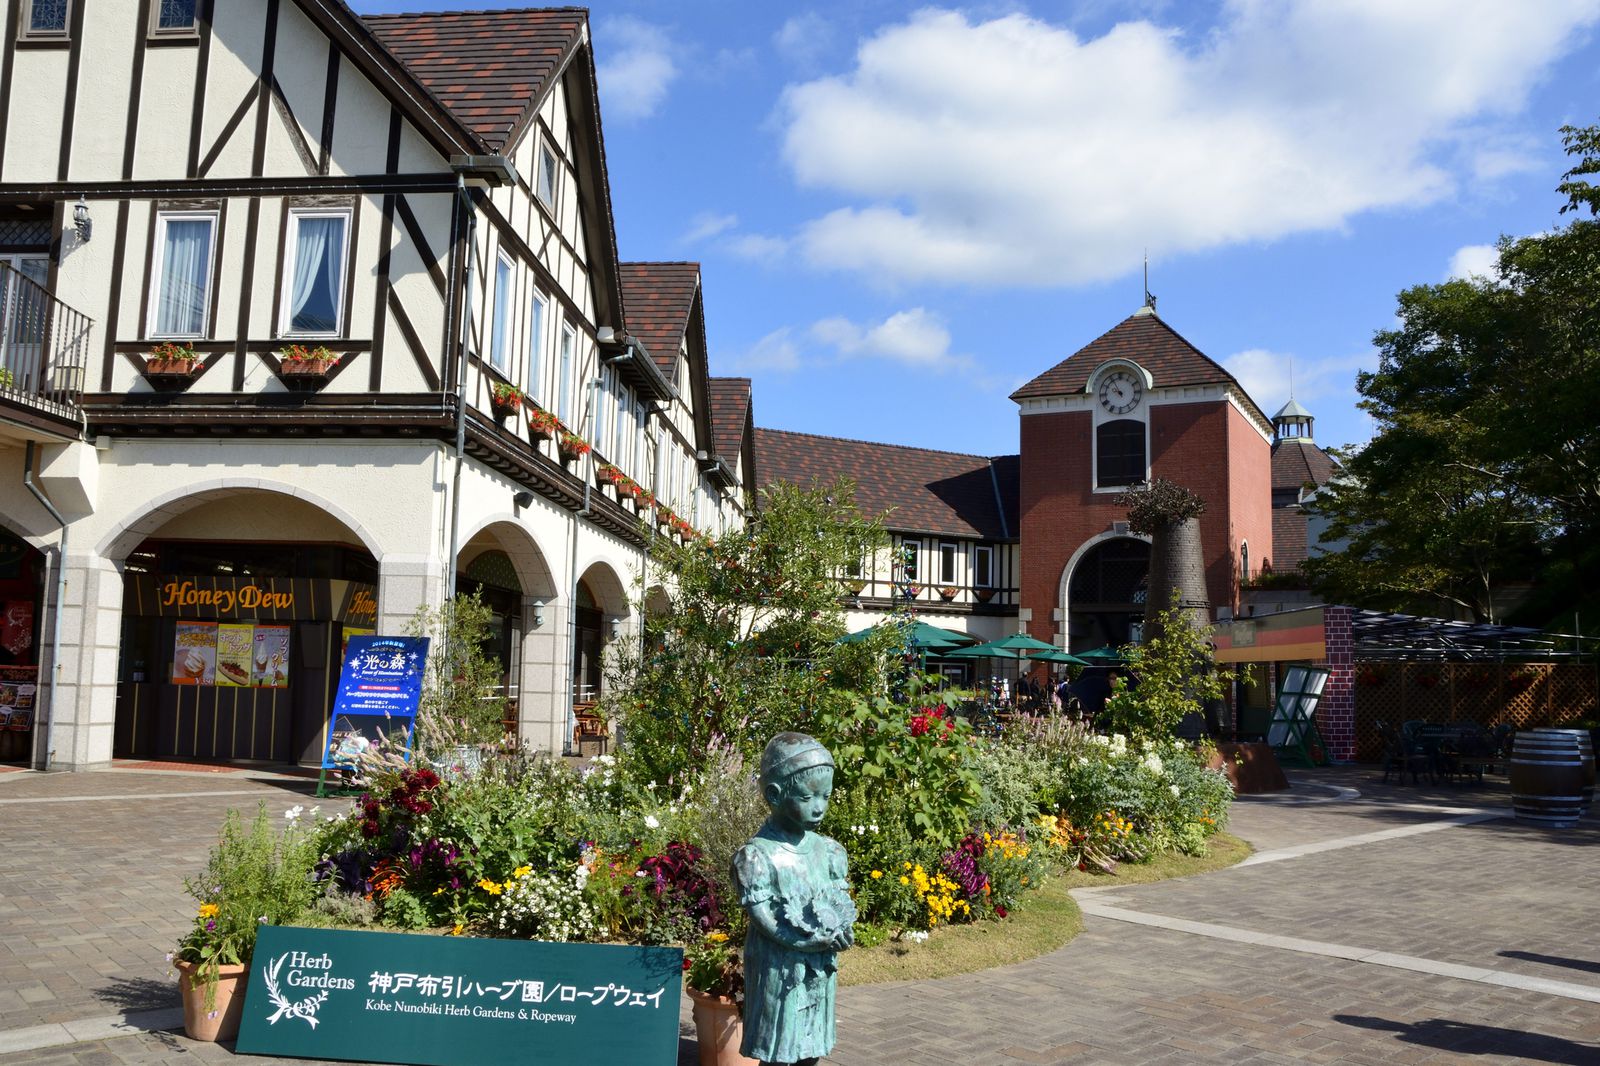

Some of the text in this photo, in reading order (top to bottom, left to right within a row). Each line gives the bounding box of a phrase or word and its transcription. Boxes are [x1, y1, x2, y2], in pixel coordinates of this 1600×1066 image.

[163, 581, 293, 612] Honey Dew
[362, 653, 406, 669] 光の森
[289, 951, 332, 969] Herb
[287, 970, 355, 989] Gardens
[365, 999, 577, 1024] Kobe Nunobiki Herb Gardens & Ropeway
